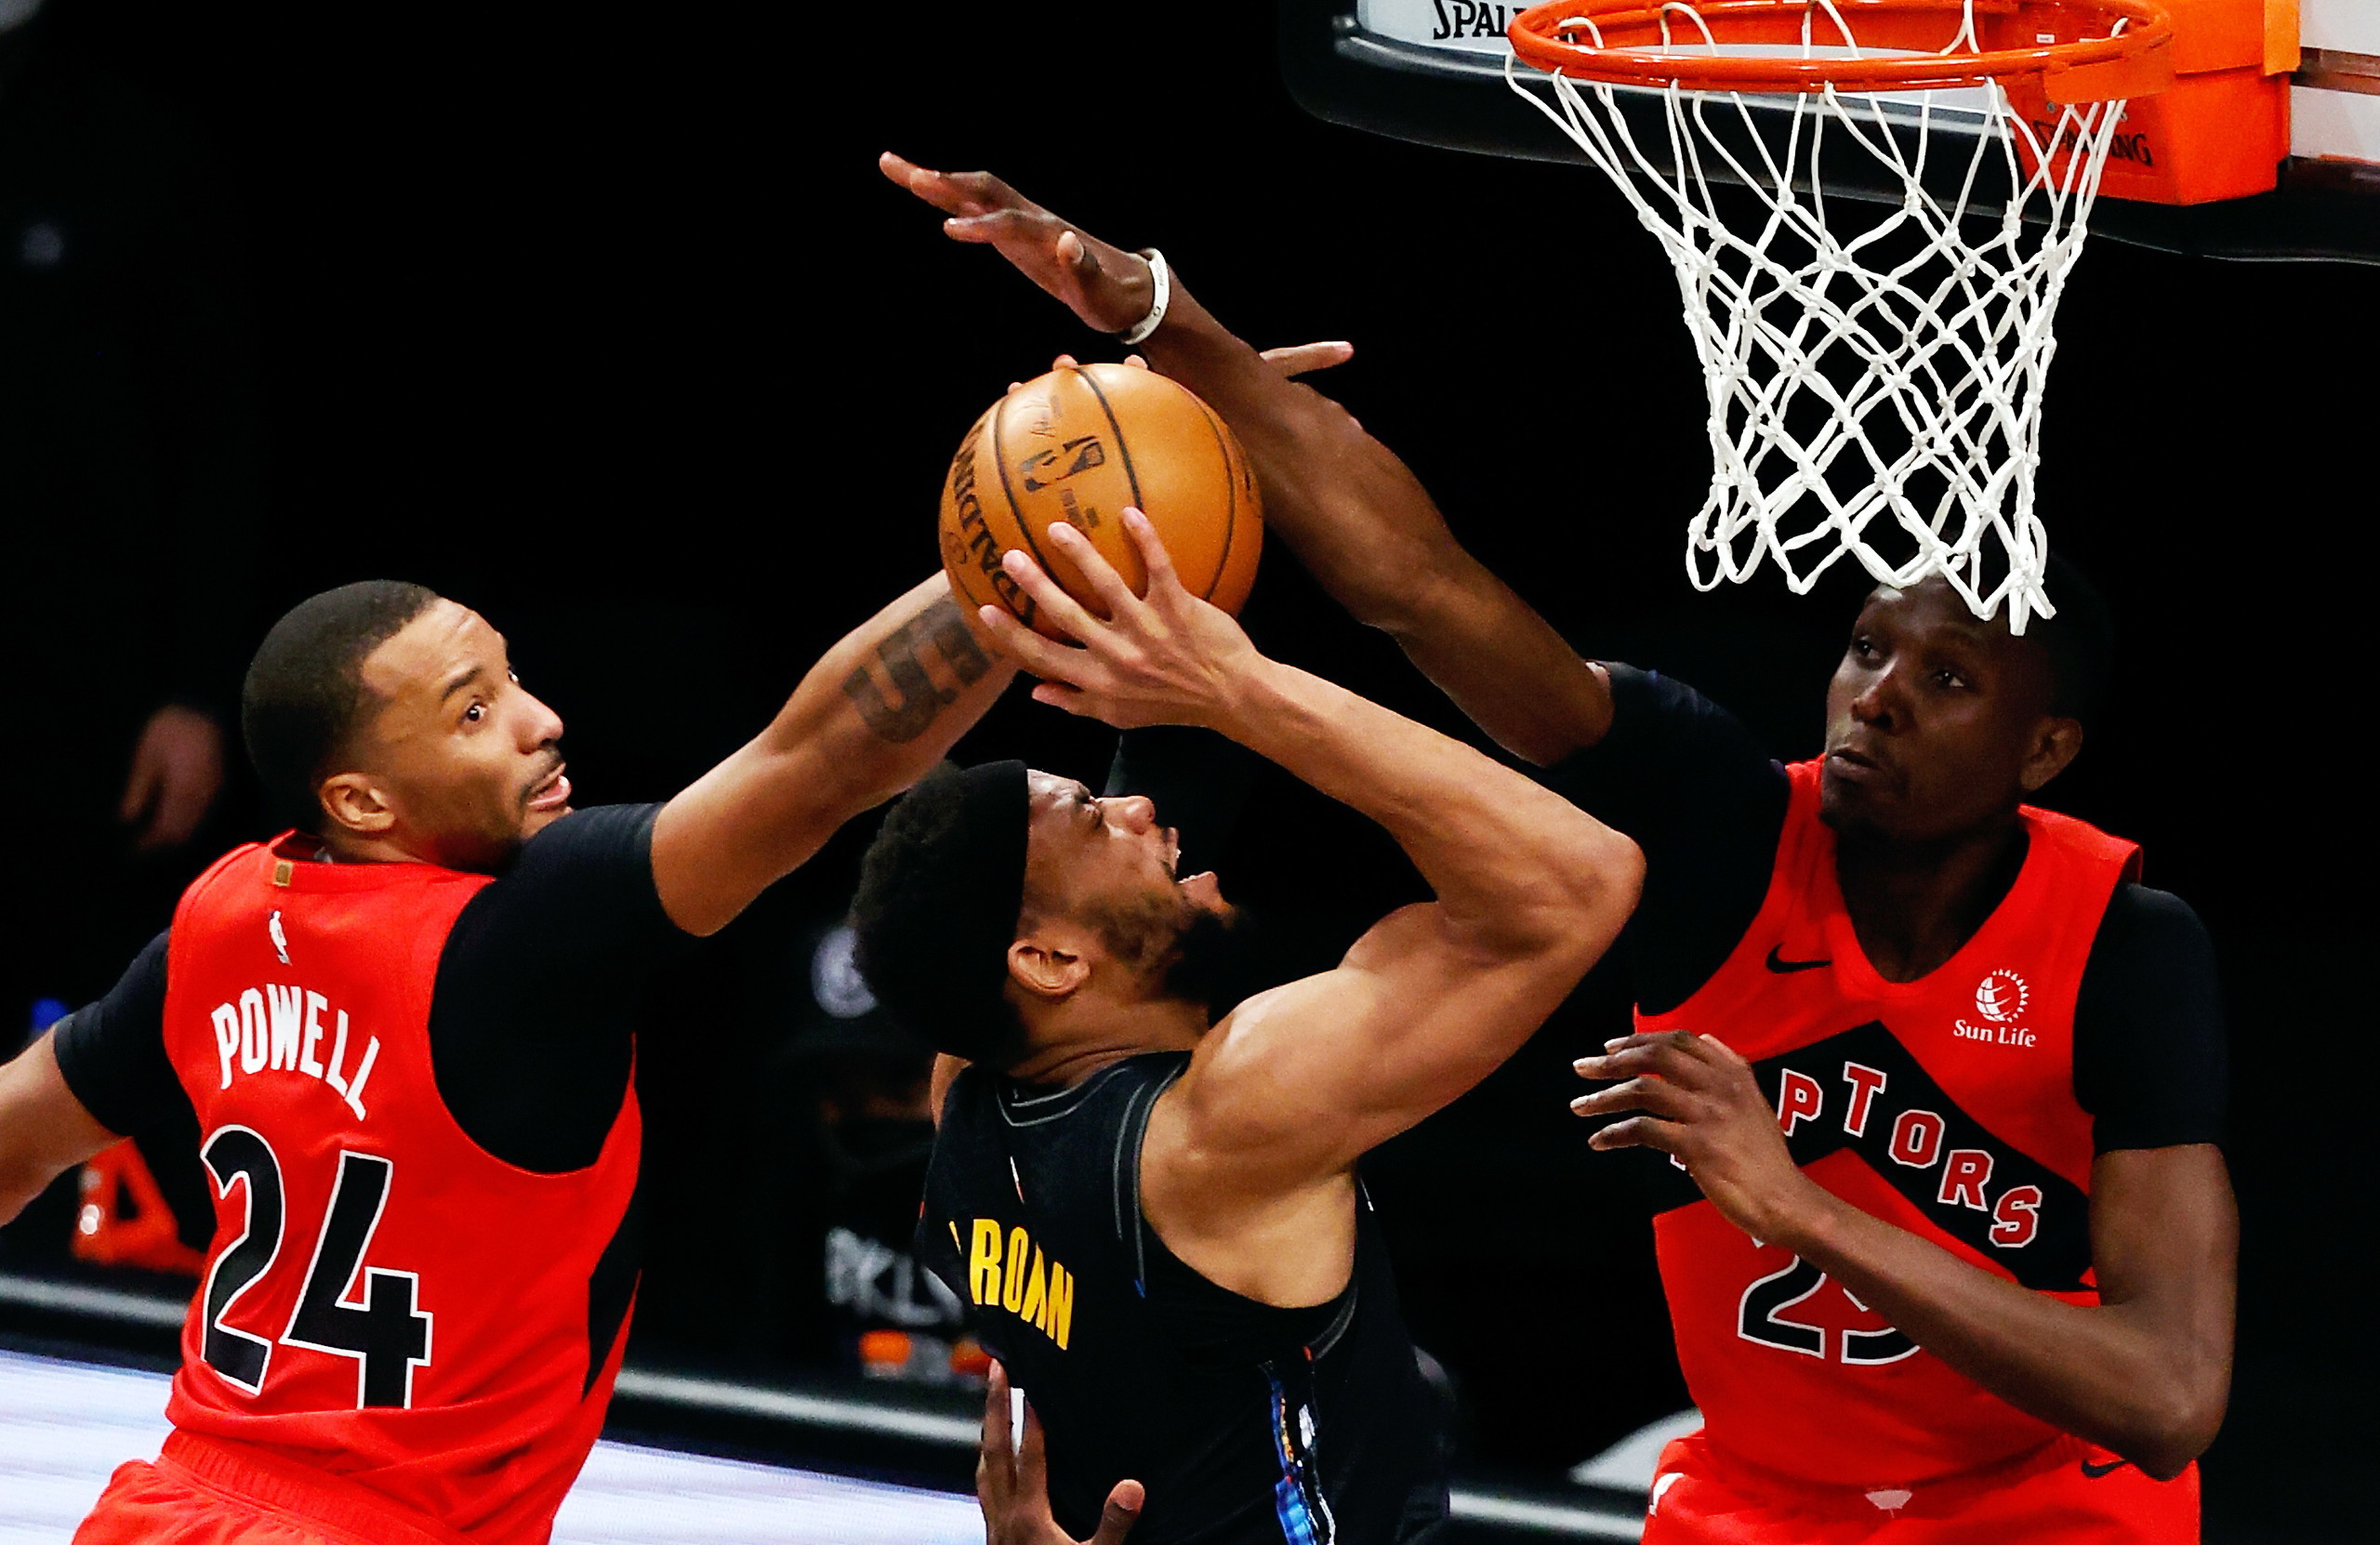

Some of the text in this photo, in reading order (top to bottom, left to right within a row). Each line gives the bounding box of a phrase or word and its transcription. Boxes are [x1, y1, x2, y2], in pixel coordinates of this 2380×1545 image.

[211, 982, 380, 1121] POWELL
[1953, 1019, 2037, 1048] Sun Life
[1670, 1061, 2043, 1248] PTORS
[200, 1124, 433, 1409] 24
